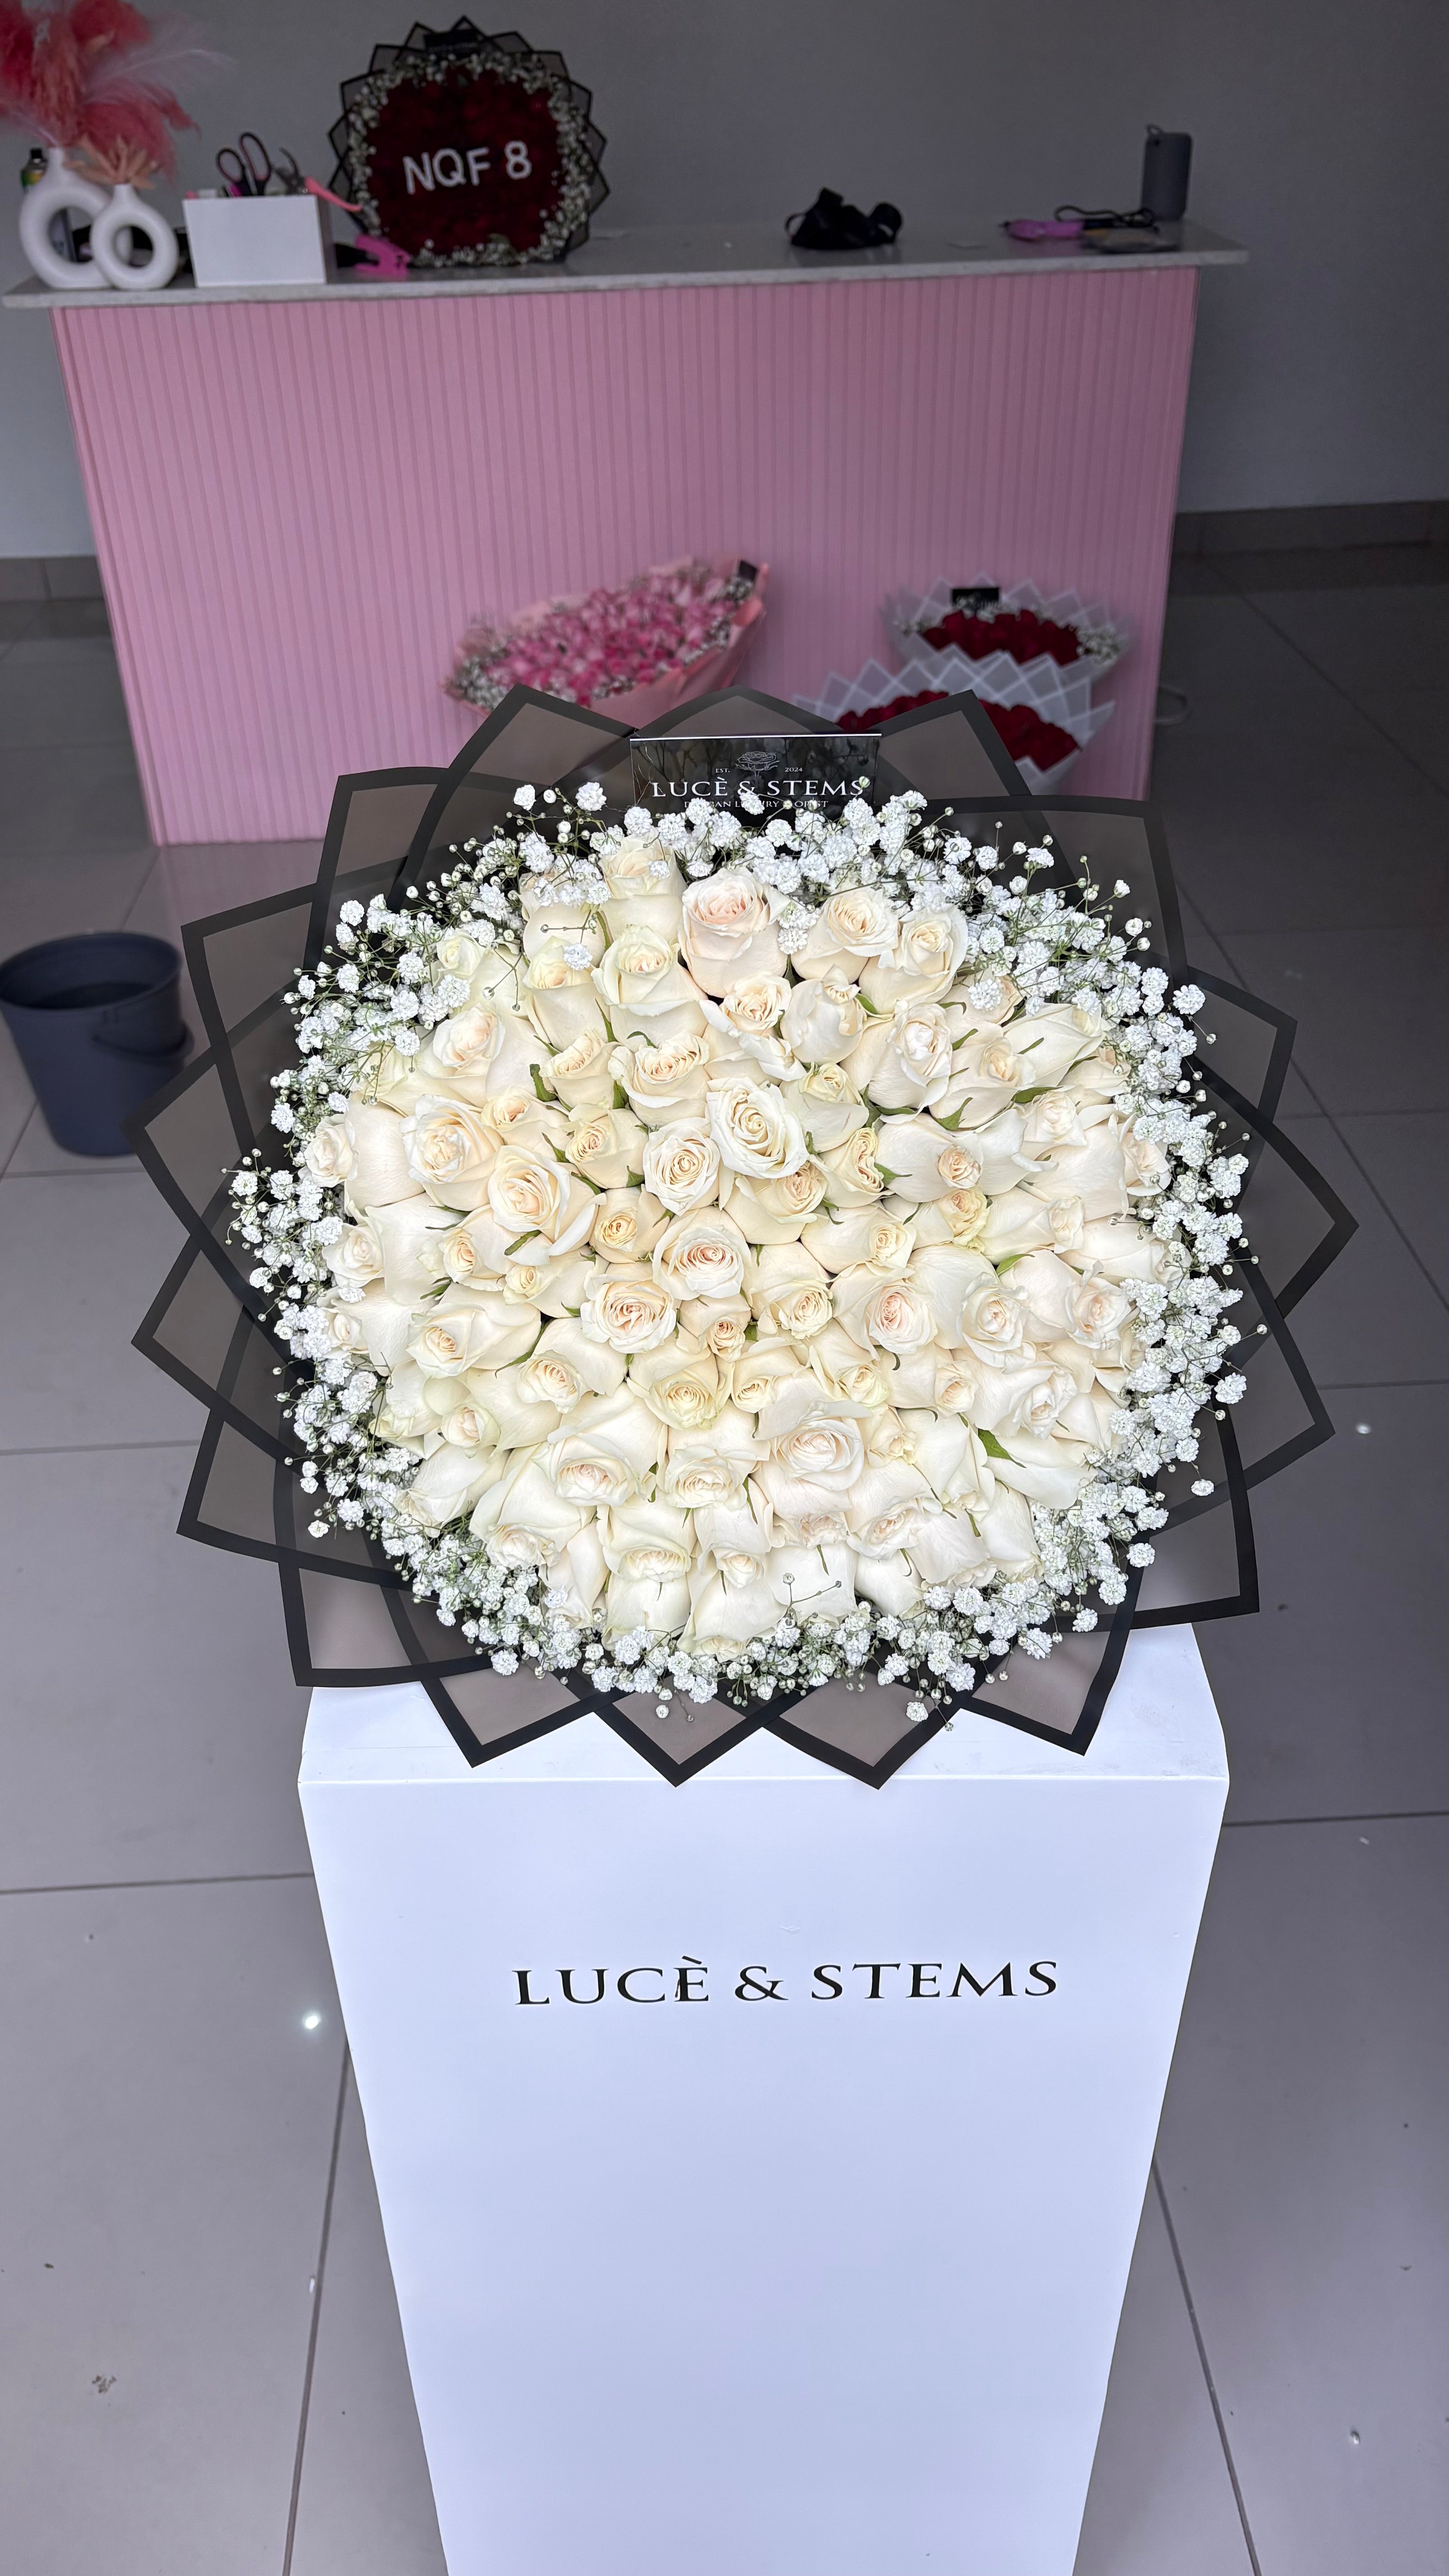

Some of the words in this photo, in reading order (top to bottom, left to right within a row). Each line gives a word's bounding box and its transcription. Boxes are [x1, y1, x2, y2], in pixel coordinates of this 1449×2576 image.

[403, 148, 491, 194] NQF
[504, 140, 532, 179] 8
[652, 777, 728, 797] LUCÈ
[737, 781, 755, 796] &
[768, 780, 863, 796] STEMS
[511, 1955, 709, 2005] LUCÈ
[734, 1965, 789, 2001] &
[811, 1961, 1057, 2000] STEMS
